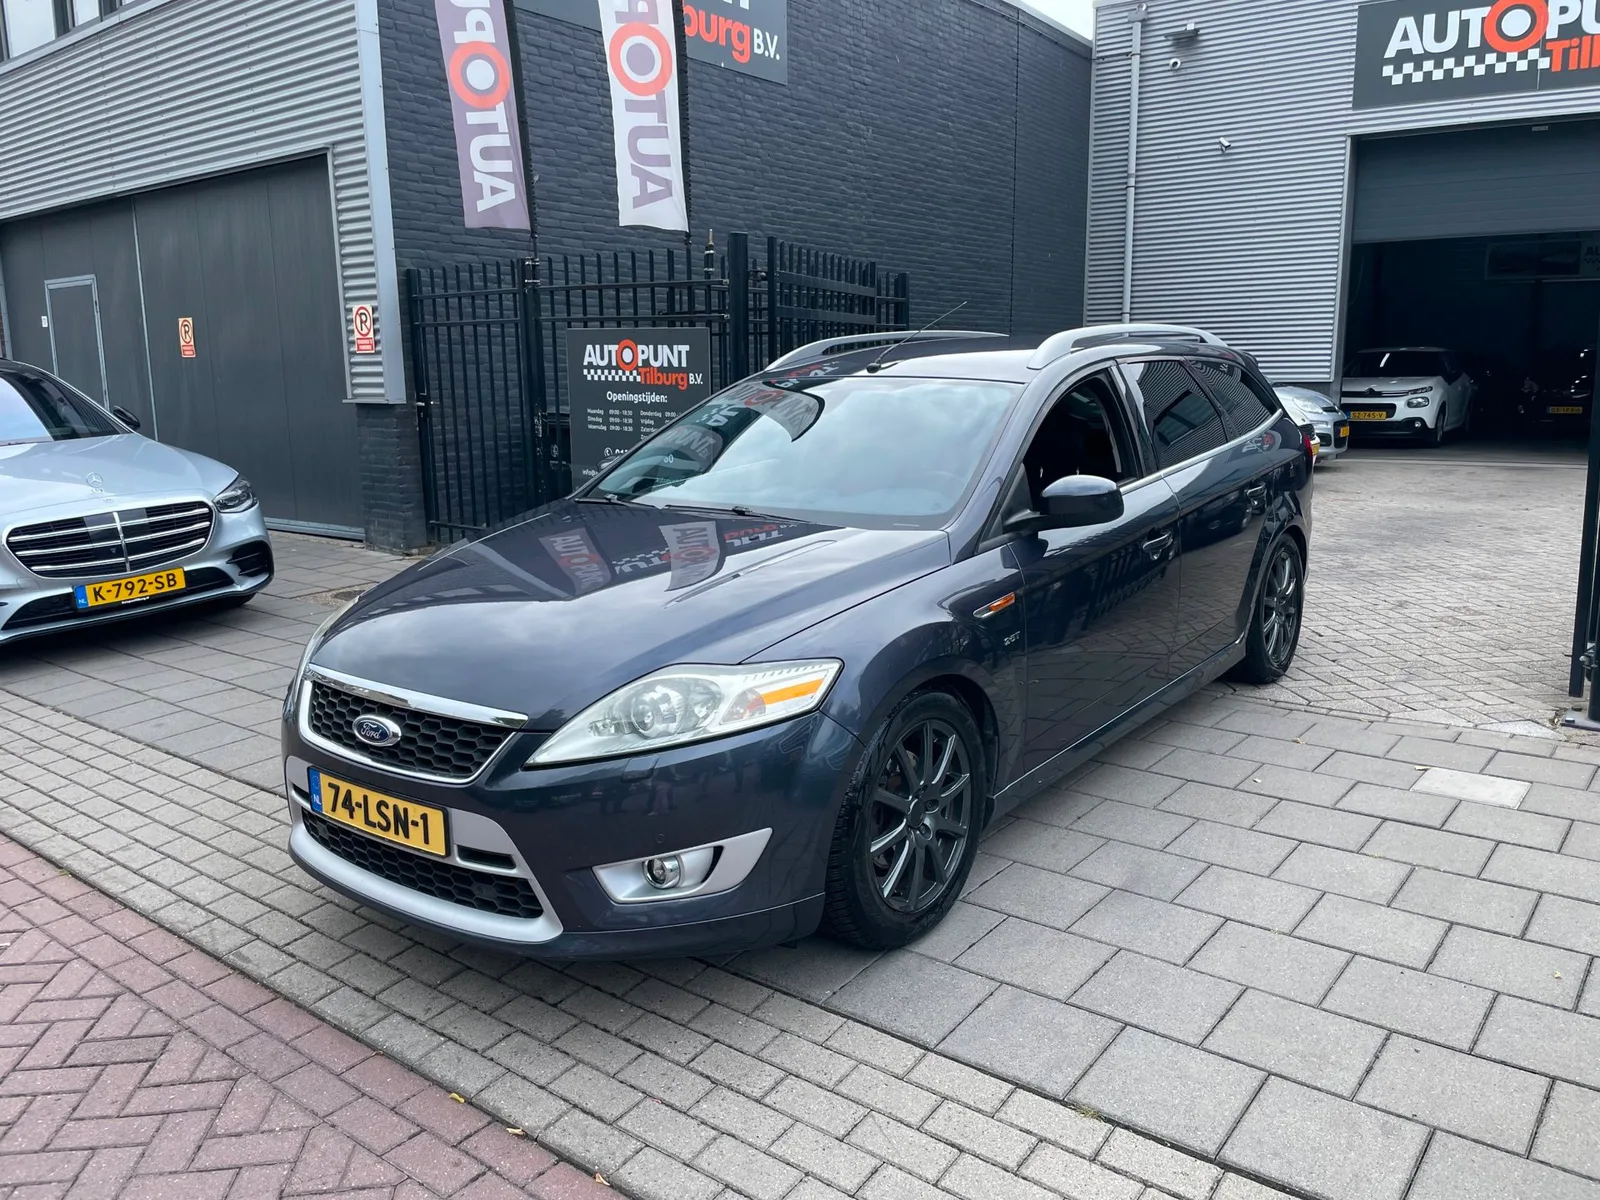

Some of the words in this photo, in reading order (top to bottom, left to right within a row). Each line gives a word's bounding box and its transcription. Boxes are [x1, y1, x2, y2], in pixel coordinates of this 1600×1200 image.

[683, 5, 750, 64] burg
[753, 27, 780, 60] B.V.
[583, 339, 690, 371] AUTOPUNT
[638, 367, 688, 391] Tilburg
[688, 373, 703, 385] B.V.
[606, 390, 668, 404] Openingstijden:
[92, 573, 177, 602] K-792-SB
[361, 722, 382, 739] Ford
[328, 782, 429, 845] 74-LSN-1
